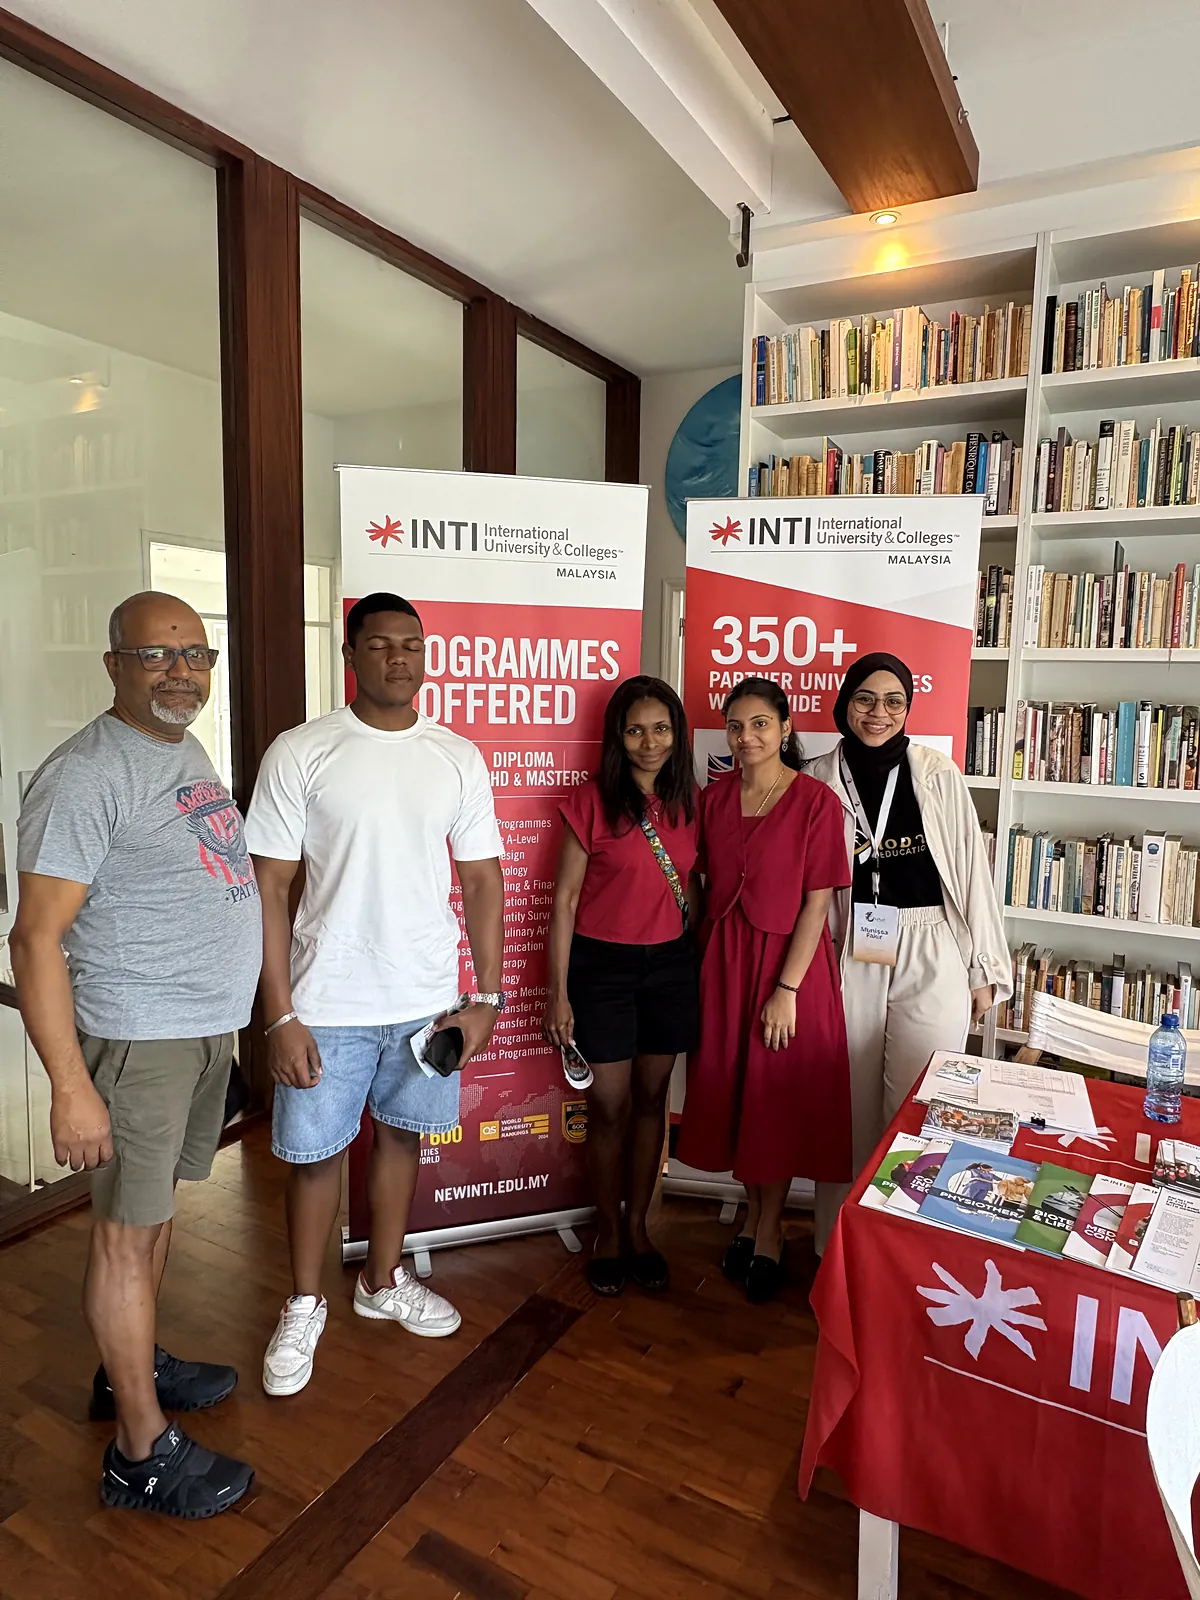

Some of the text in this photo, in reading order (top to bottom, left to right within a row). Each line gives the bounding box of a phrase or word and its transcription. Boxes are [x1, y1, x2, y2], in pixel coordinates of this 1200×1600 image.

[965, 433, 979, 494] HENRIQUE GA
[818, 516, 902, 530] International
[411, 518, 478, 552] INTI
[485, 522, 570, 541] International
[748, 517, 812, 545] INTI
[817, 530, 882, 546] University
[884, 532, 895, 544] &
[484, 538, 552, 558] University
[552, 543, 563, 556] &
[888, 554, 952, 565] MALAYSIA
[556, 568, 617, 580] MALAYSIA
[710, 616, 857, 667] 350+
[424, 634, 620, 681] OGRAMMES
[418, 682, 577, 726] OFFERED
[493, 751, 555, 768] DIPLOMA
[489, 770, 588, 787] HD & MASTERS
[496, 818, 552, 831] Programmes
[506, 833, 539, 845] A-Level
[879, 844, 926, 859] EDUCATIO
[501, 865, 528, 877] nology
[226, 880, 260, 904] PATR
[503, 879, 555, 893] ting & Fina
[505, 895, 528, 907] ation
[503, 911, 526, 923] ntity
[504, 925, 549, 938] ulinary Art
[503, 940, 544, 953] unication
[502, 959, 527, 969] erapy
[501, 973, 521, 985] logy
[520, 986, 548, 997] Medic
[501, 1002, 532, 1014] ransfer
[493, 1017, 528, 1031] ransfer
[492, 1031, 543, 1046] Programme
[498, 1046, 554, 1060] Programmes
[501, 1117, 522, 1125] WORLD
[482, 1125, 497, 1135] QS
[420, 1147, 439, 1157] ITIES
[915, 1175, 933, 1184] CO
[434, 1173, 550, 1203] NEWINTI.EDU.MY
[1034, 1209, 1075, 1226] BIOTE
[1084, 1229, 1116, 1243] COM
[1086, 1224, 1117, 1238] MED
[1070, 1294, 1163, 1406] IN
